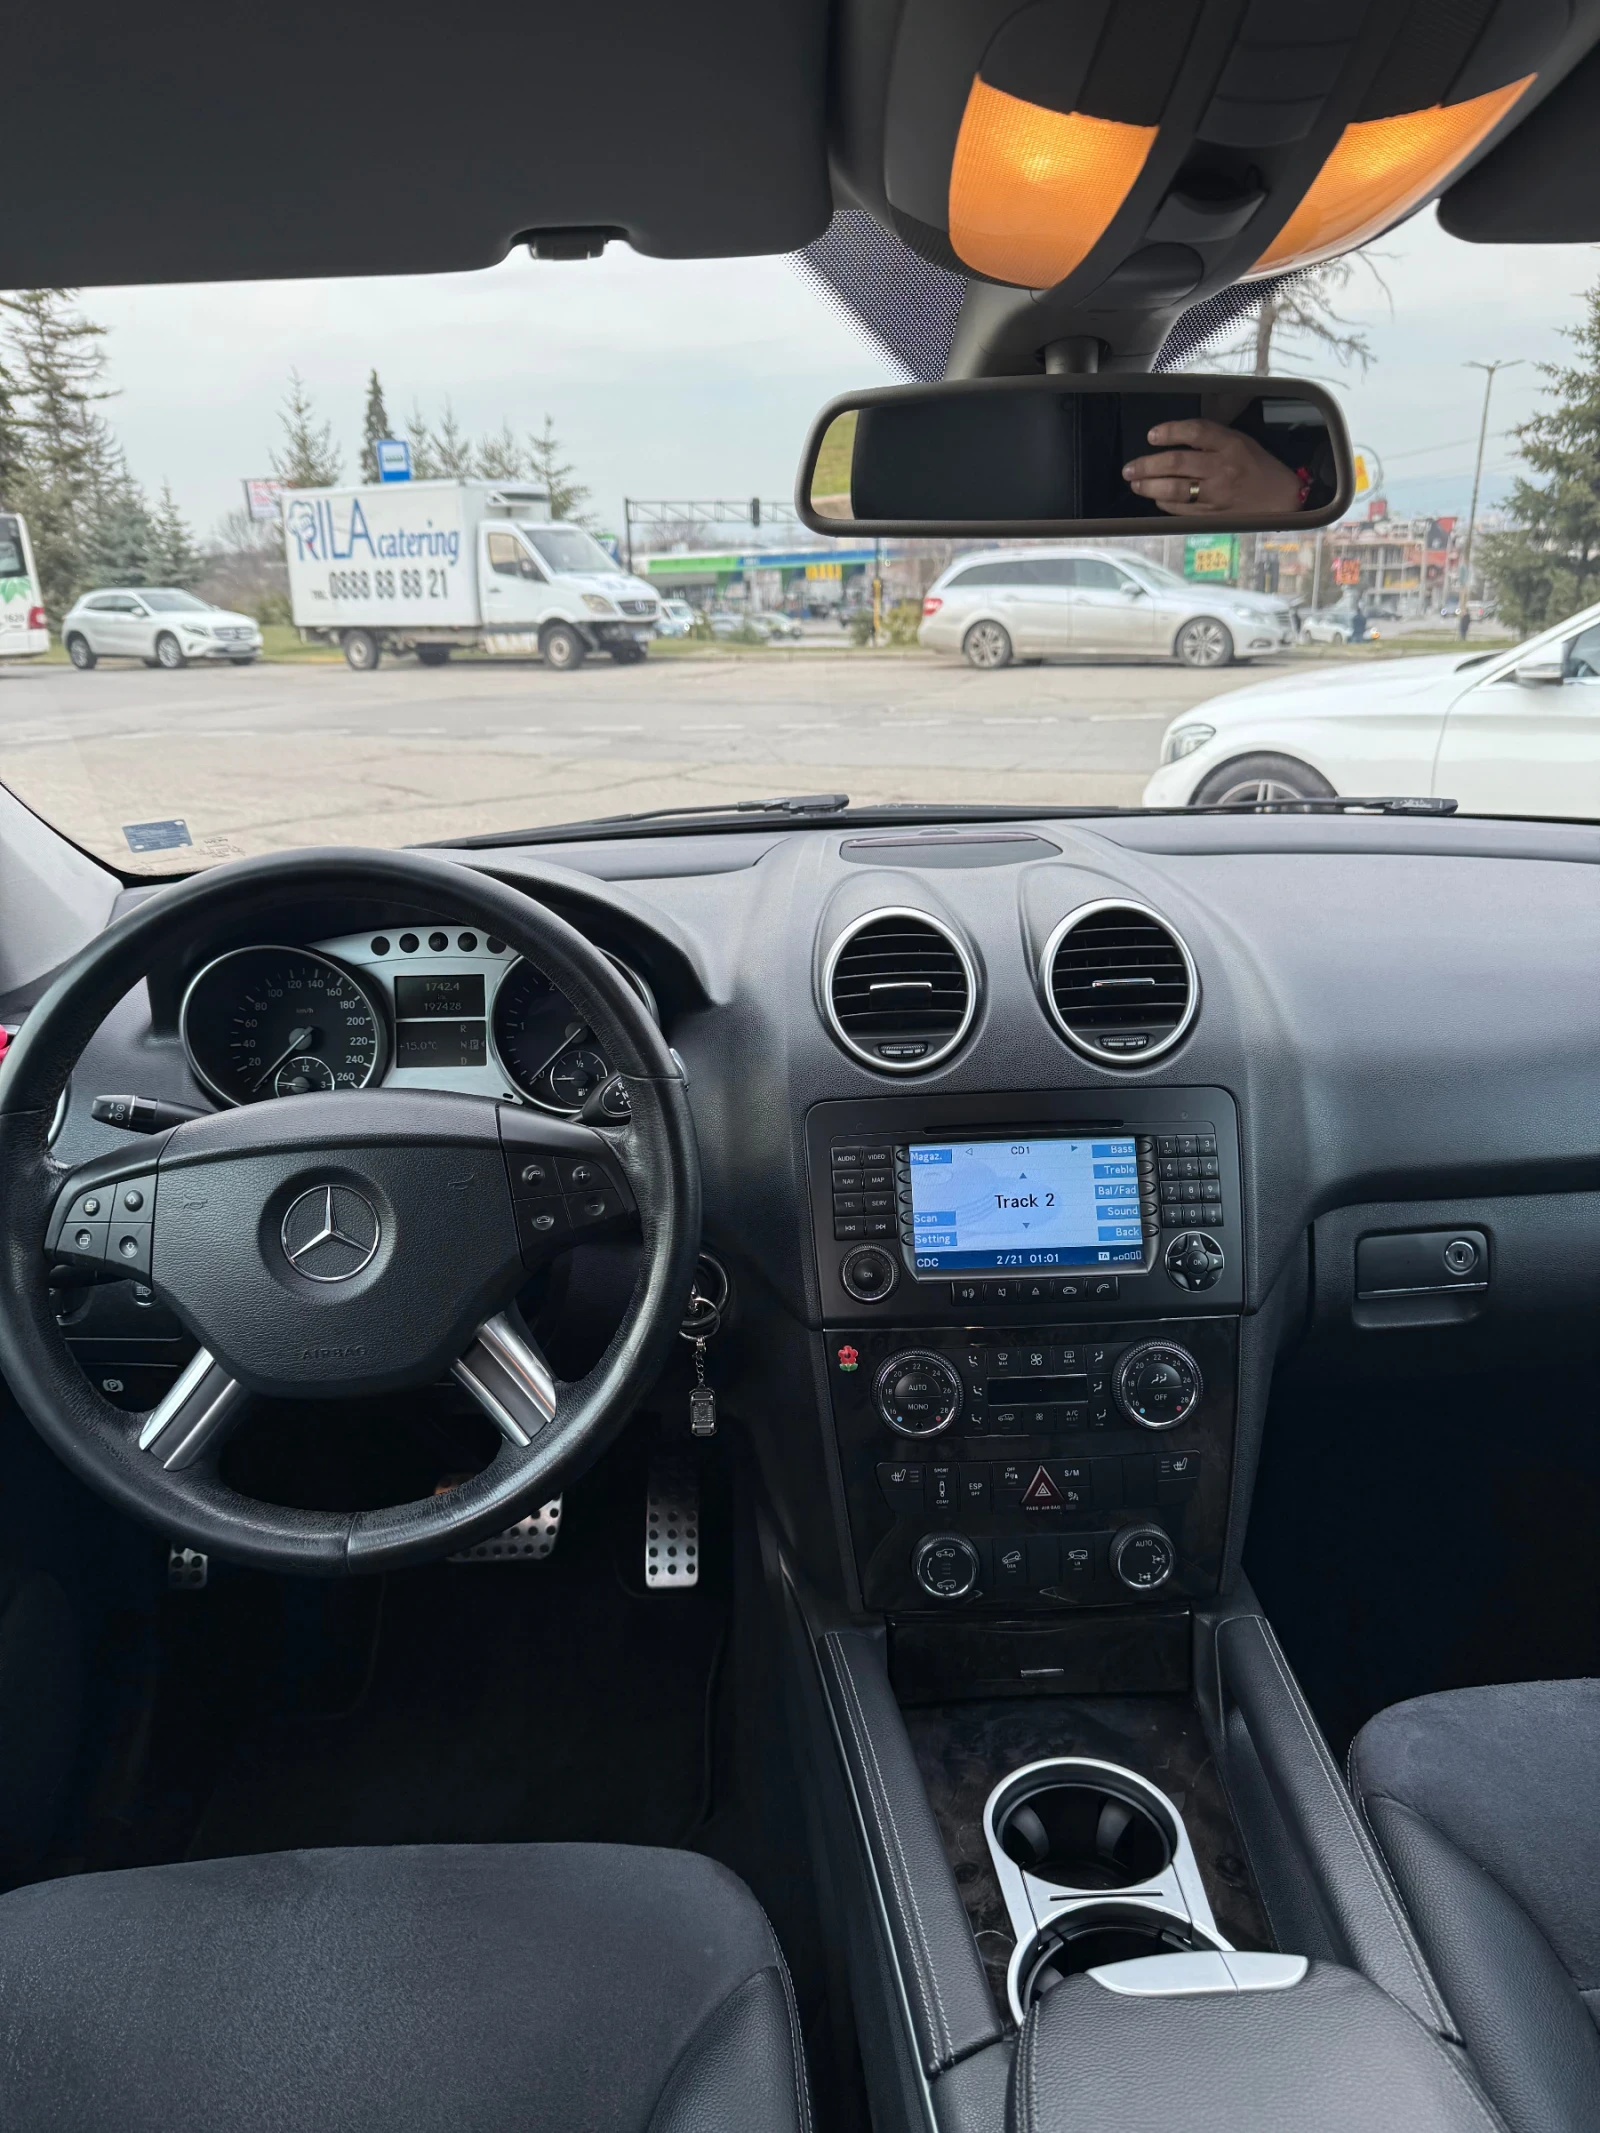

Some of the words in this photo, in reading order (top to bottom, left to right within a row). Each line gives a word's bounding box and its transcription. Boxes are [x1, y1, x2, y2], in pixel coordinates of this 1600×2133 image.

[378, 519, 459, 567] catering
[427, 567, 448, 598] 21
[287, 980, 302, 989] 120
[308, 979, 325, 988] 140
[425, 982, 460, 991] 1742.4
[268, 989, 283, 998] 100
[326, 988, 342, 997] 160
[255, 1002, 268, 1011] 80
[340, 1001, 356, 1010] 180
[245, 1019, 258, 1028] 60
[346, 1017, 365, 1026] 200
[460, 1025, 467, 1033] R
[243, 1040, 256, 1049] 40
[350, 1037, 368, 1046] 220
[248, 1057, 261, 1067] 20
[346, 1055, 364, 1064] 240
[460, 1057, 467, 1066] D
[301, 1065, 310, 1073] 12
[337, 1073, 355, 1082] 260
[320, 1081, 327, 1089] 3
[617, 1082, 625, 1091] R
[621, 1090, 629, 1100] N
[1110, 1145, 1134, 1153] Bass
[911, 1152, 943, 1162] Magaz.
[1104, 1166, 1134, 1174] Treble
[1098, 1186, 1137, 1195] Bal/Fad
[994, 1193, 1039, 1209] Track
[1045, 1193, 1055, 1207] 2
[1107, 1206, 1138, 1216] Sound
[914, 1214, 938, 1223] Scan
[1116, 1227, 1140, 1236] Back
[915, 1234, 951, 1245] Setting
[916, 1258, 939, 1268] CDC
[996, 1255, 1023, 1265] 2/21
[1029, 1253, 1059, 1263] 01:01
[1064, 1469, 1080, 1477] S/M
[1135, 1539, 1153, 1547] AUTO
